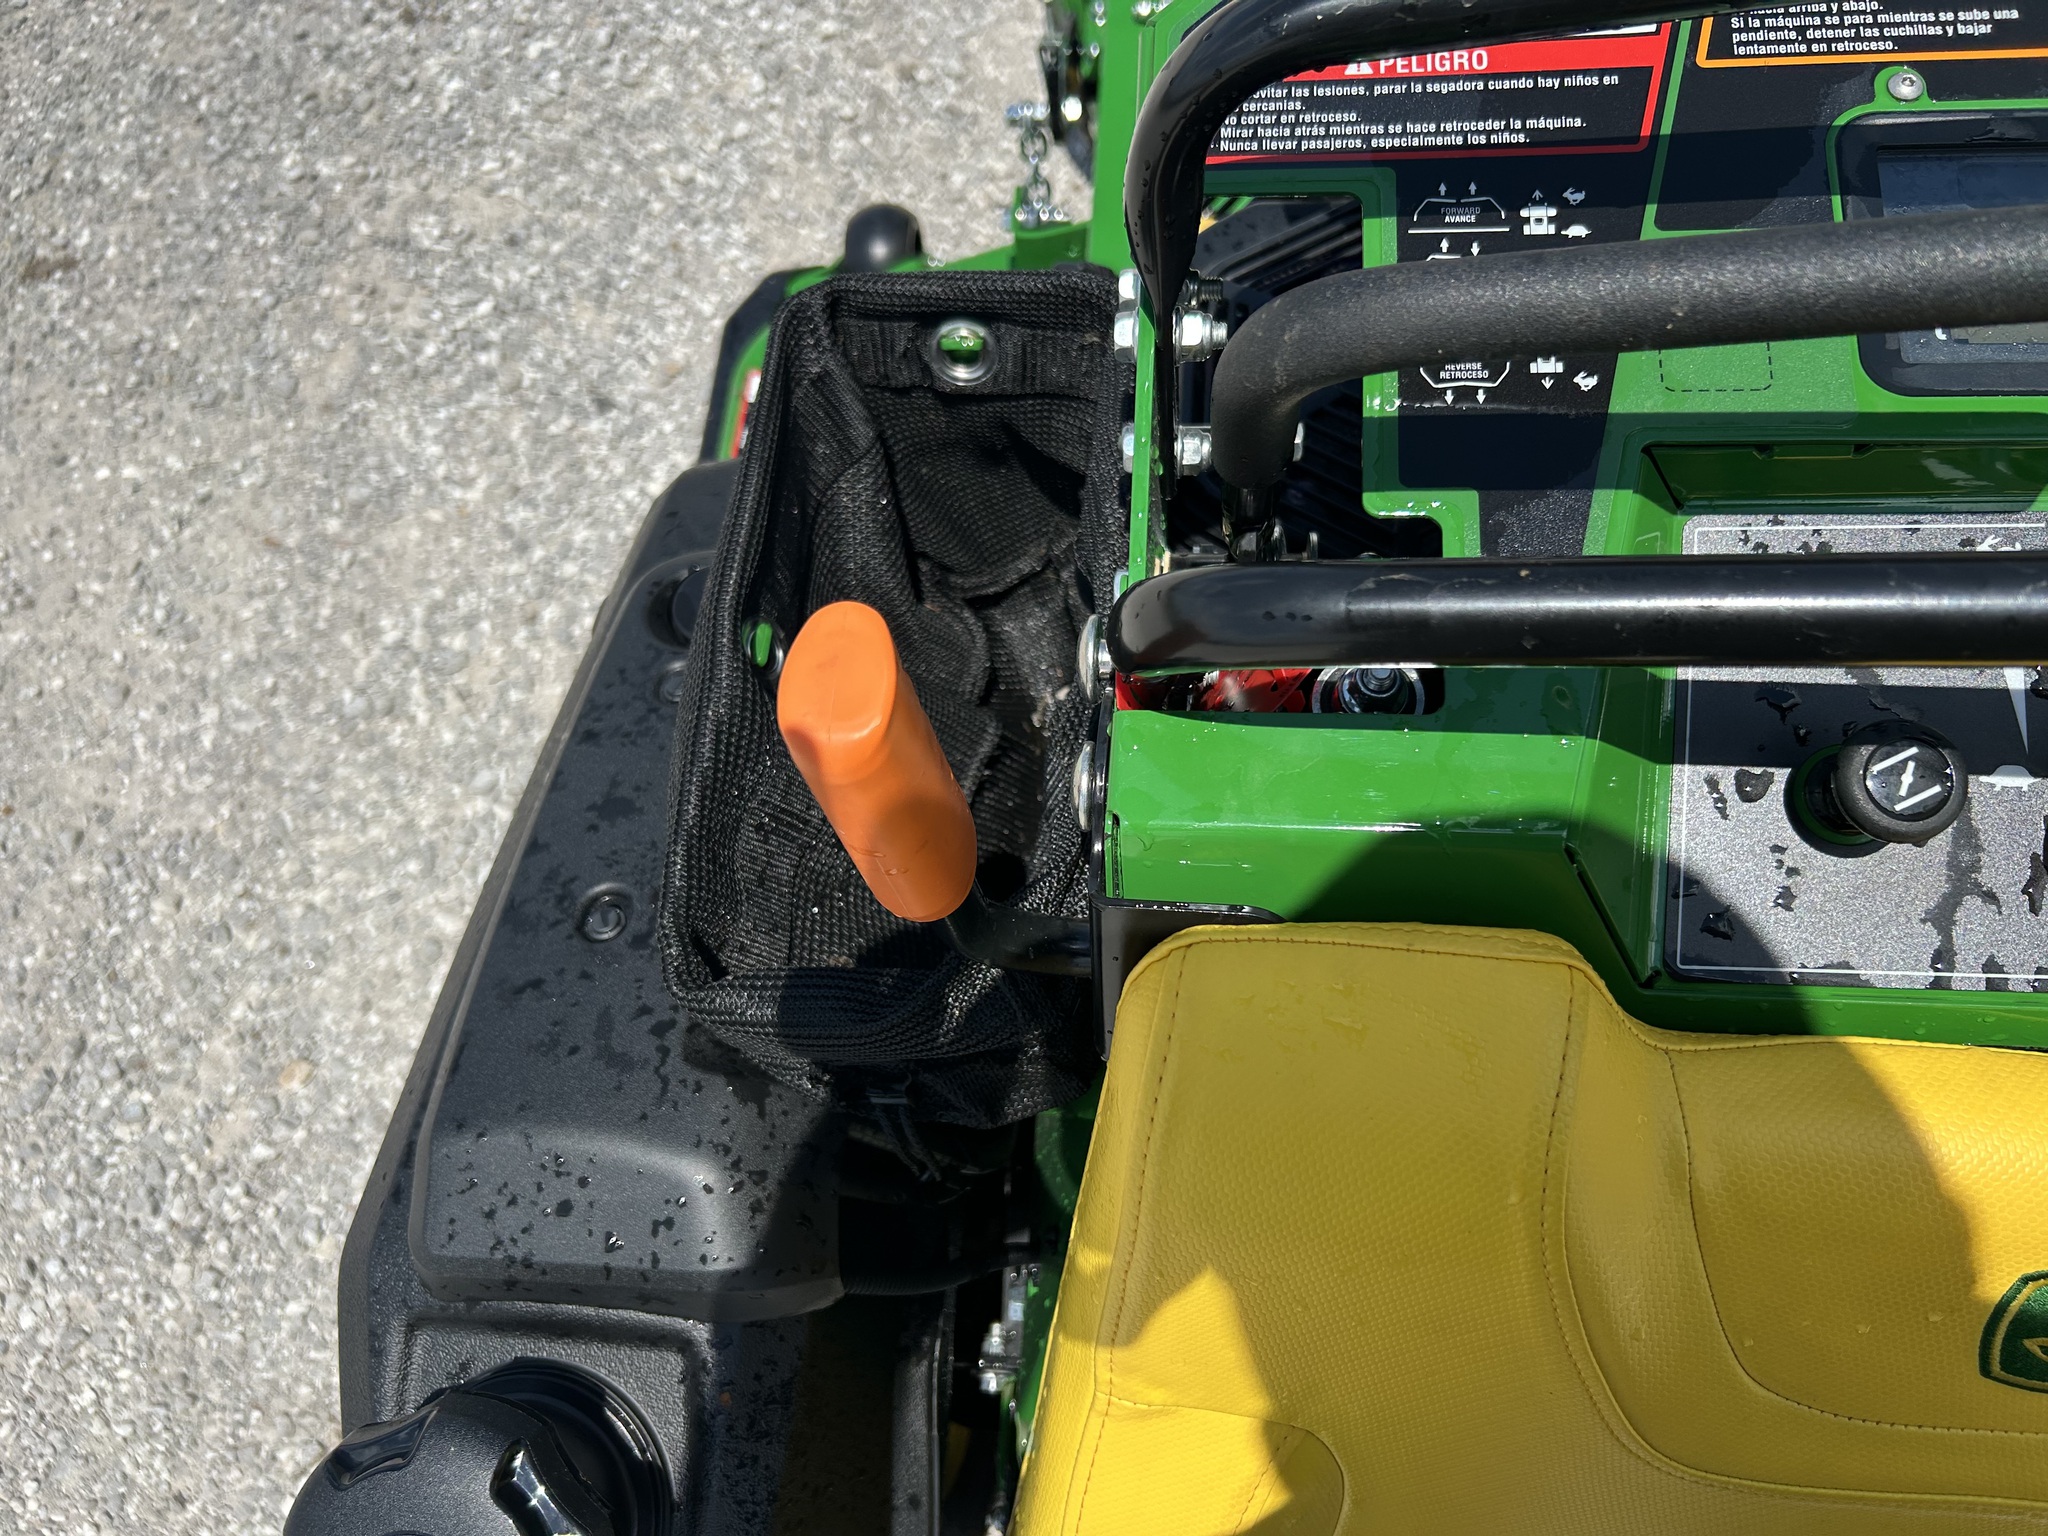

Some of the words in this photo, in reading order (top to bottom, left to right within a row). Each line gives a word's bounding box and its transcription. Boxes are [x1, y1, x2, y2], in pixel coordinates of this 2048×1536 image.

[1788, 3, 1827, 13] arriba
[1831, 3, 1838, 13] y
[1842, 0, 1883, 12] abajo.
[1731, 17, 1744, 28] Si
[1748, 17, 1760, 28] la
[1765, 15, 1820, 28] máquina
[1825, 16, 1840, 25] se
[1844, 14, 1873, 26] para
[1878, 12, 1935, 24] mientras
[1938, 12, 1954, 21] se
[1958, 10, 1990, 20] sube
[1993, 10, 2019, 20] una
[1732, 30, 1802, 44] pendiente,
[1806, 28, 1856, 39] detener
[1860, 26, 1880, 37] las
[1884, 24, 1943, 36] cuchillas
[1946, 26, 1954, 36] y
[1957, 22, 1992, 36] bajar
[1734, 43, 1807, 55] lentamente
[1812, 43, 1828, 52] en
[1832, 40, 1898, 52] retroceso.
[1380, 50, 1488, 74] PELIGRO
[1292, 86, 1310, 98] las
[1314, 84, 1370, 97] lesiones,
[1374, 82, 1407, 97] parar
[1410, 82, 1422, 92] la
[1426, 78, 1484, 94] segadora
[1488, 76, 1534, 90] cuando
[1538, 76, 1560, 89] hay
[1564, 74, 1599, 86] niños
[1603, 75, 1619, 86] en
[1240, 114, 1276, 125] cortar
[1280, 114, 1295, 124] en
[1300, 111, 1361, 122] retroceso.
[1220, 126, 1253, 138] Mirar
[1258, 125, 1288, 137] hacia
[1294, 123, 1325, 136] atrás
[1330, 122, 1384, 136] mientras
[1388, 123, 1402, 134] se
[1406, 120, 1436, 133] hace
[1440, 118, 1506, 132] retroceder
[1510, 118, 1522, 130] la
[1526, 116, 1586, 131] máquina.
[1220, 139, 1258, 151] Nunca
[1262, 138, 1298, 150] llevar
[1302, 136, 1366, 151] pasajeros,
[1371, 132, 1463, 148] especialmente
[1468, 133, 1486, 144] los
[1490, 130, 1530, 144] niños.
[1444, 215, 1476, 223] AVANCE
[1445, 362, 1482, 370] REVERSE
[1440, 370, 1489, 380] RETROCESO
